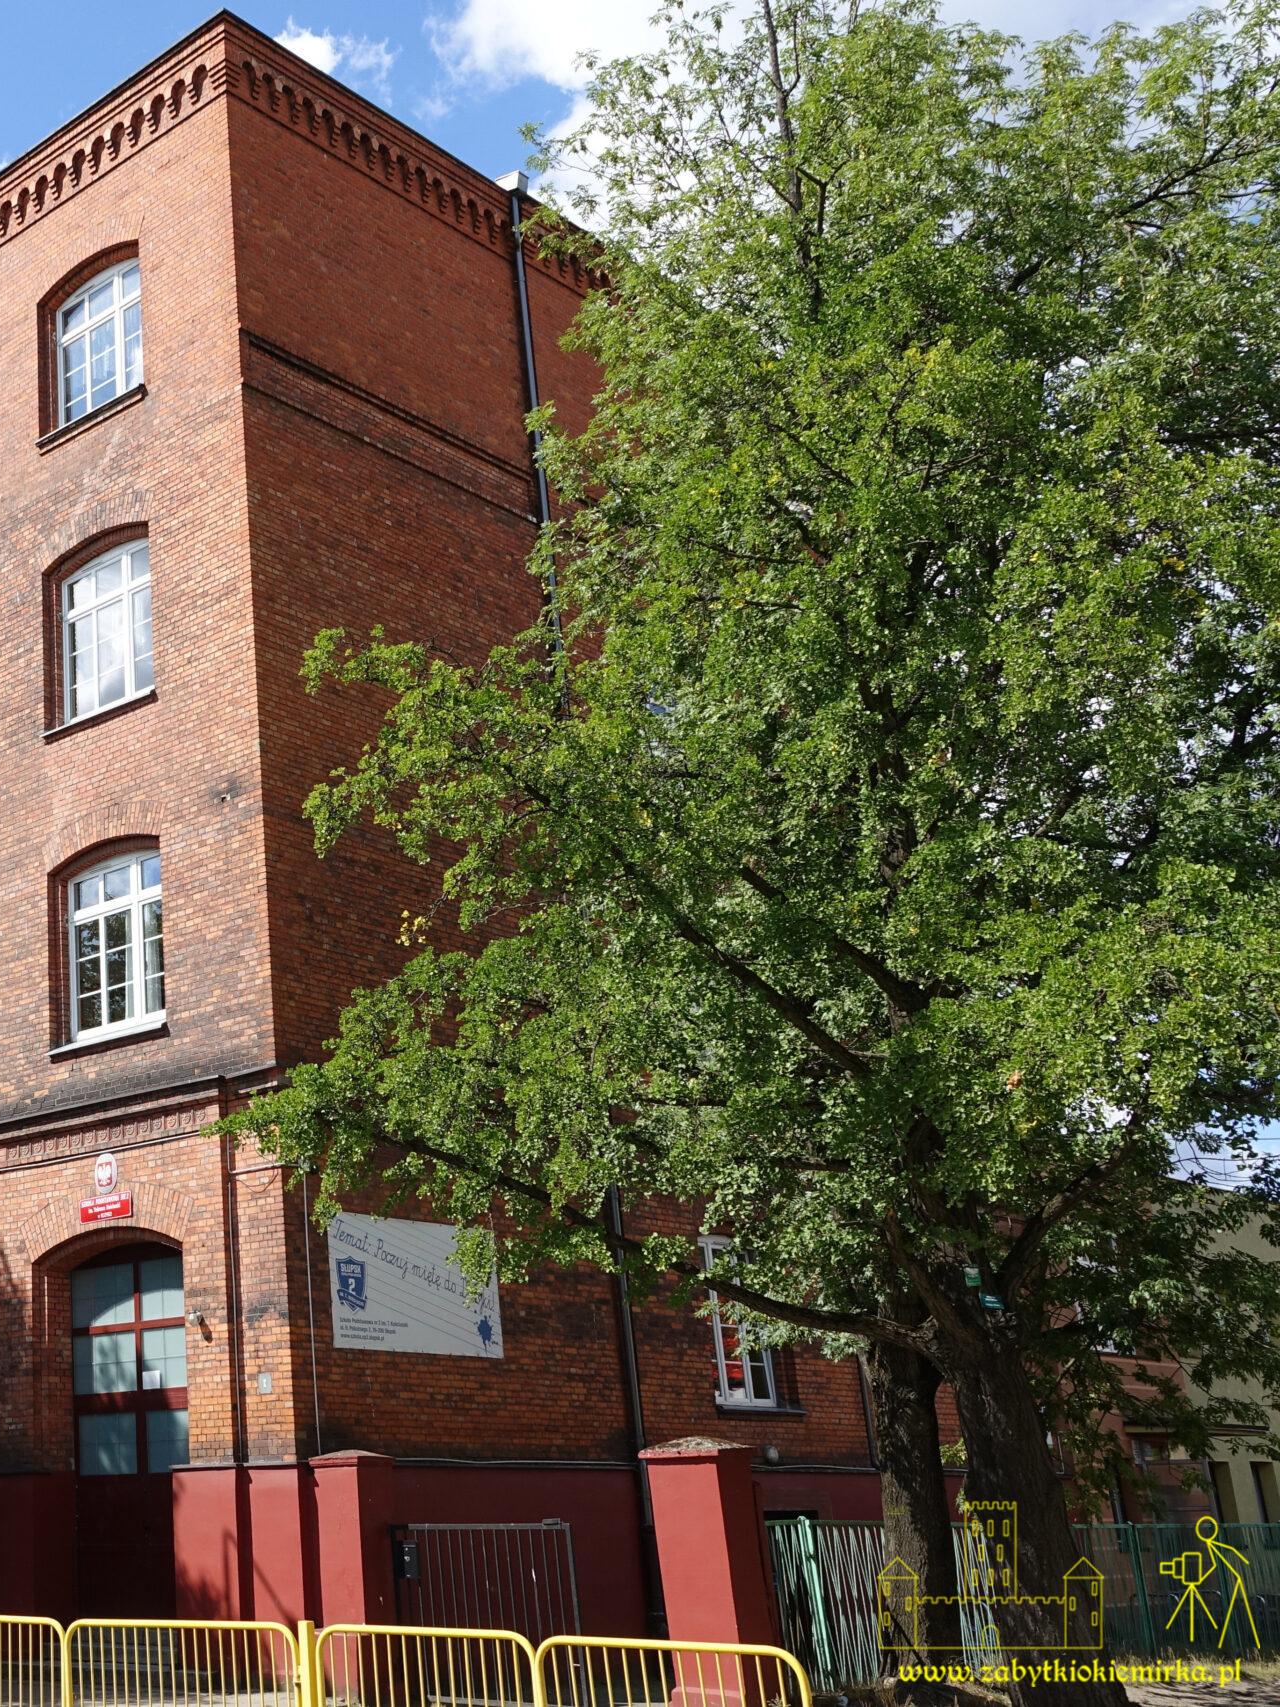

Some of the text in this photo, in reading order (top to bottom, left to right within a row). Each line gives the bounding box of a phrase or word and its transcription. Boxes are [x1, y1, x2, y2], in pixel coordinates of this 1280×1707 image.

[333, 1218, 373, 1256] Temat:
[374, 1238, 409, 1279] Poczuj
[411, 1264, 441, 1291] miętę
[444, 1271, 457, 1293] do
[348, 1278, 356, 1295] 2
